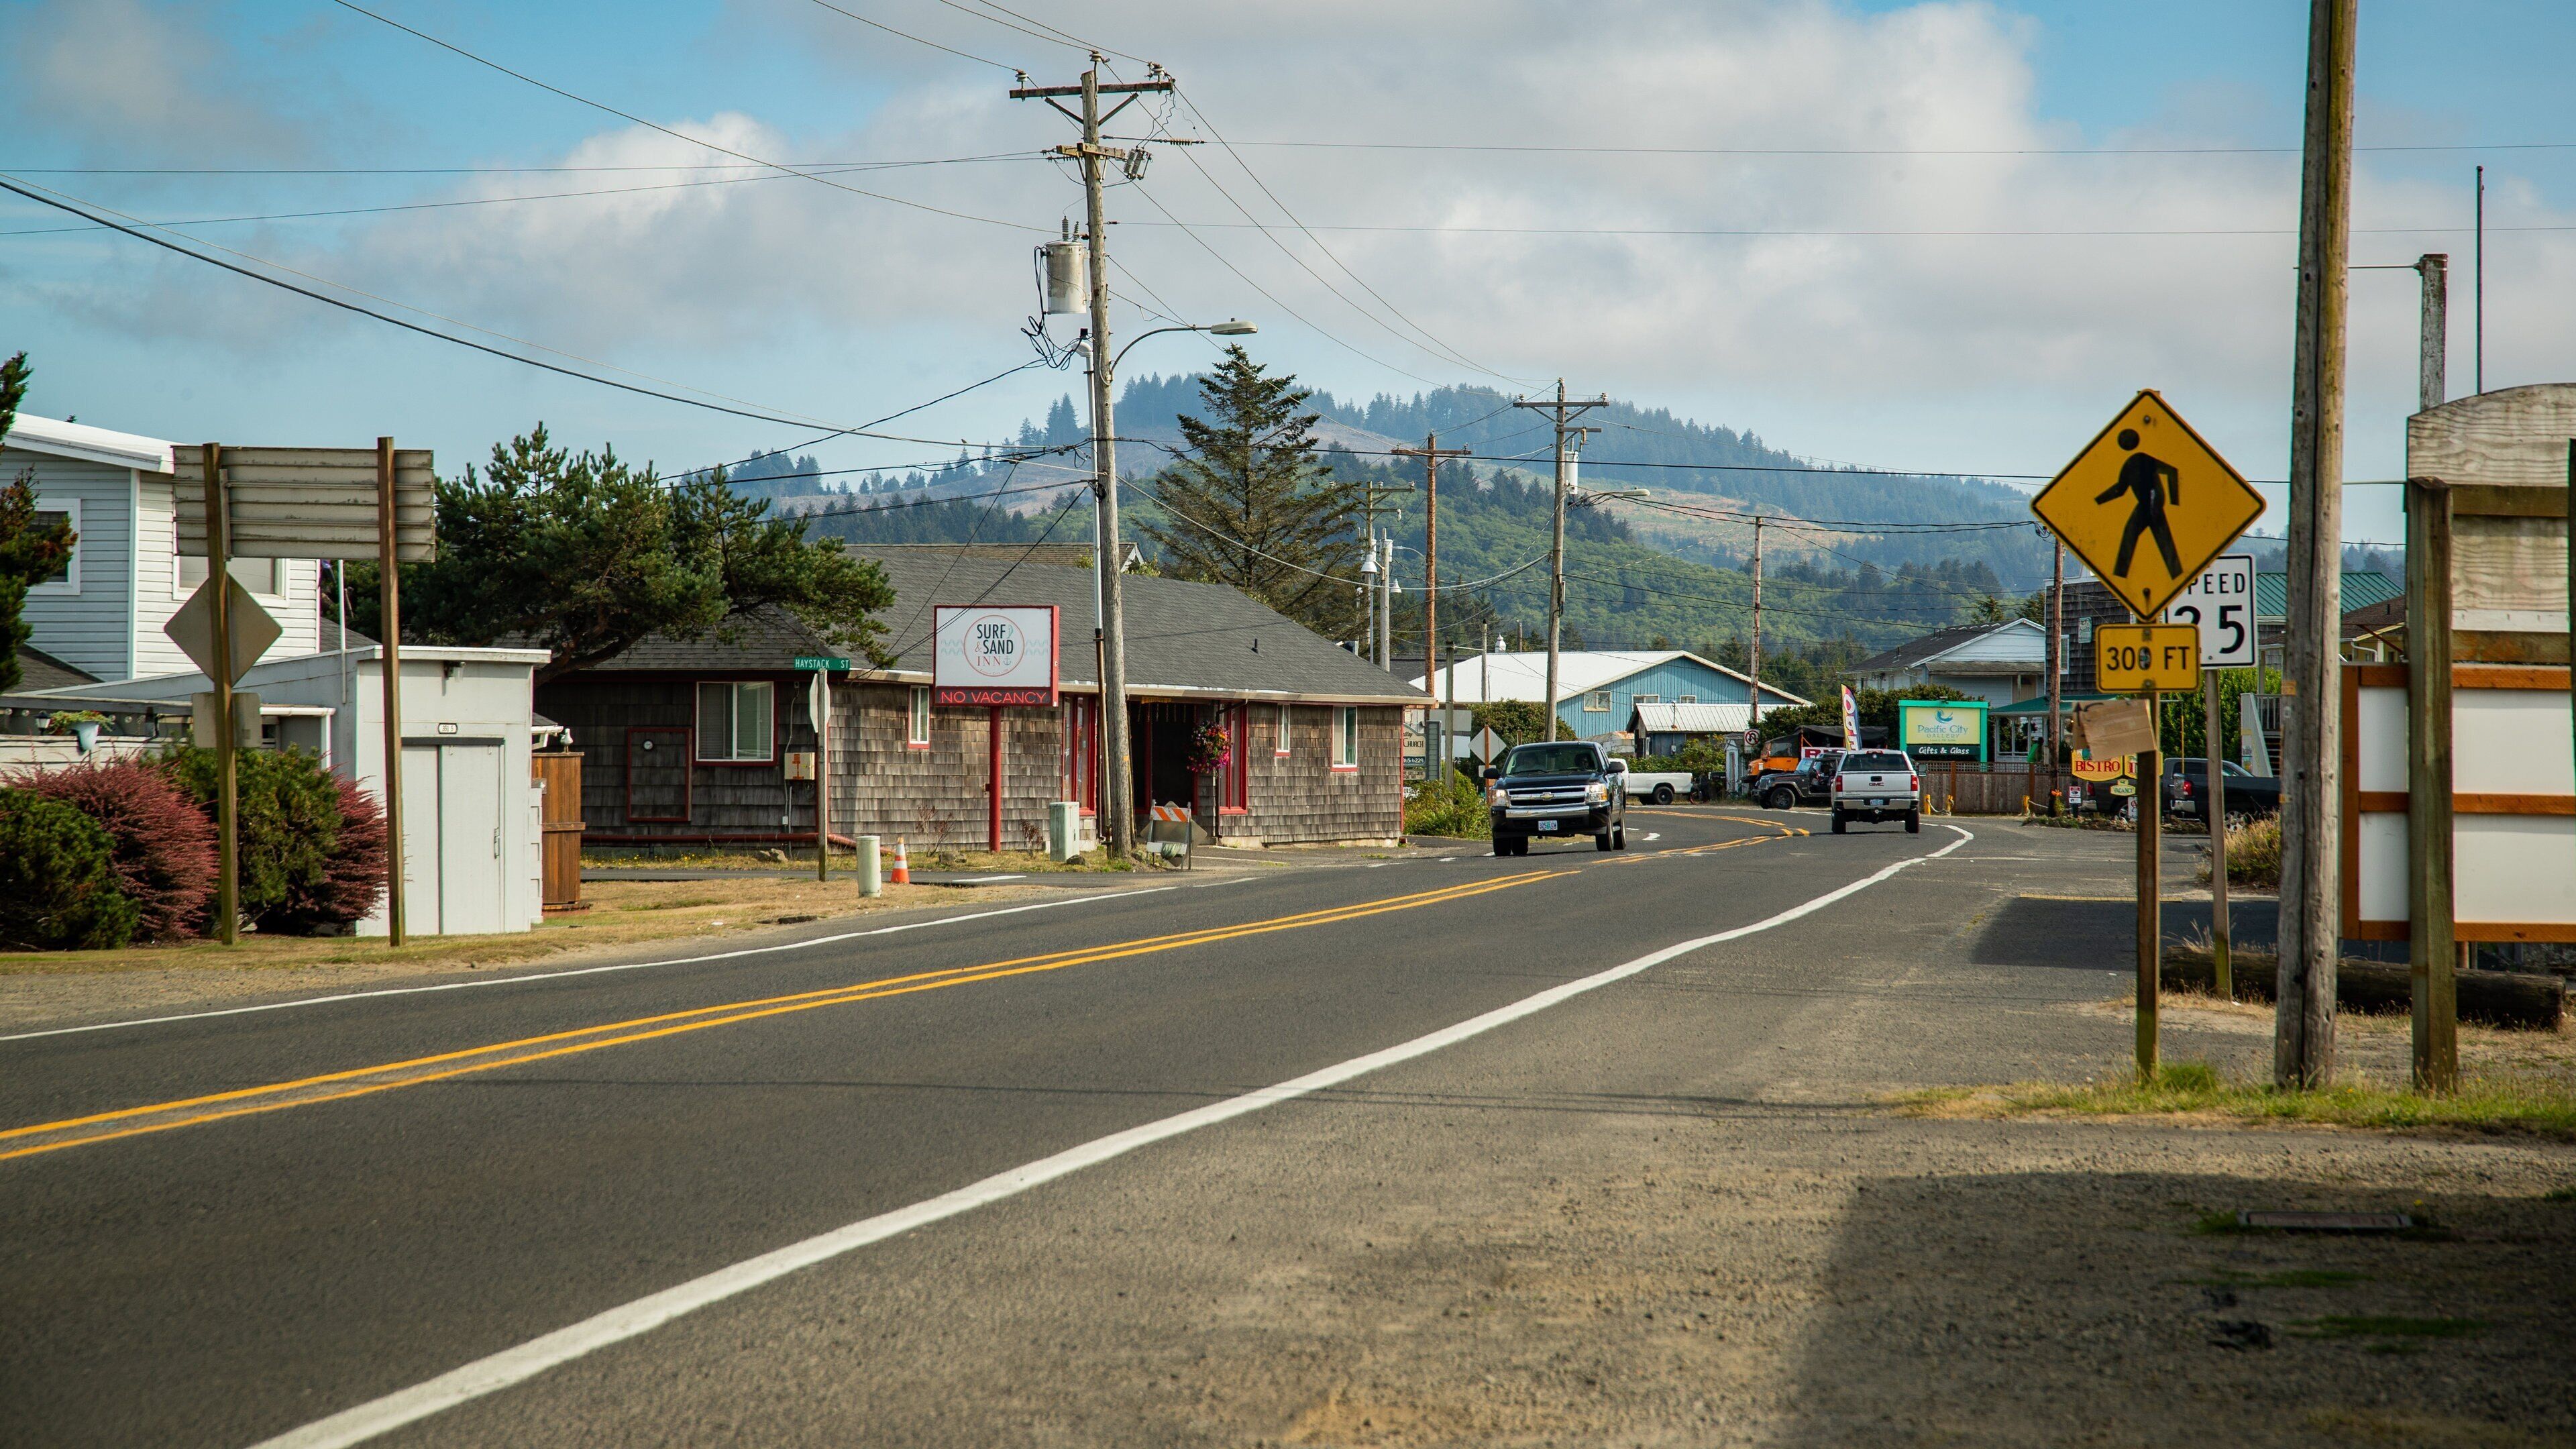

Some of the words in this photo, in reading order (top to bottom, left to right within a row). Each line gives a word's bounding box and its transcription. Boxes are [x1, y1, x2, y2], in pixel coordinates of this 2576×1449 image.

[2188, 574, 2245, 594] PEED
[977, 624, 1006, 639] SURF
[983, 639, 1014, 654] SAND
[795, 659, 830, 668] HAYSTACK
[841, 659, 849, 668] ST
[977, 656, 1001, 666] INN
[2106, 646, 2151, 671] 300
[2164, 646, 2190, 670] FT
[941, 691, 965, 704] NO
[971, 692, 1046, 704] VACANCY
[1917, 725, 1945, 733] Pacific
[1949, 725, 1968, 734] City
[1919, 747, 1938, 755] Gifts
[2076, 760, 2121, 772] BISTRO
